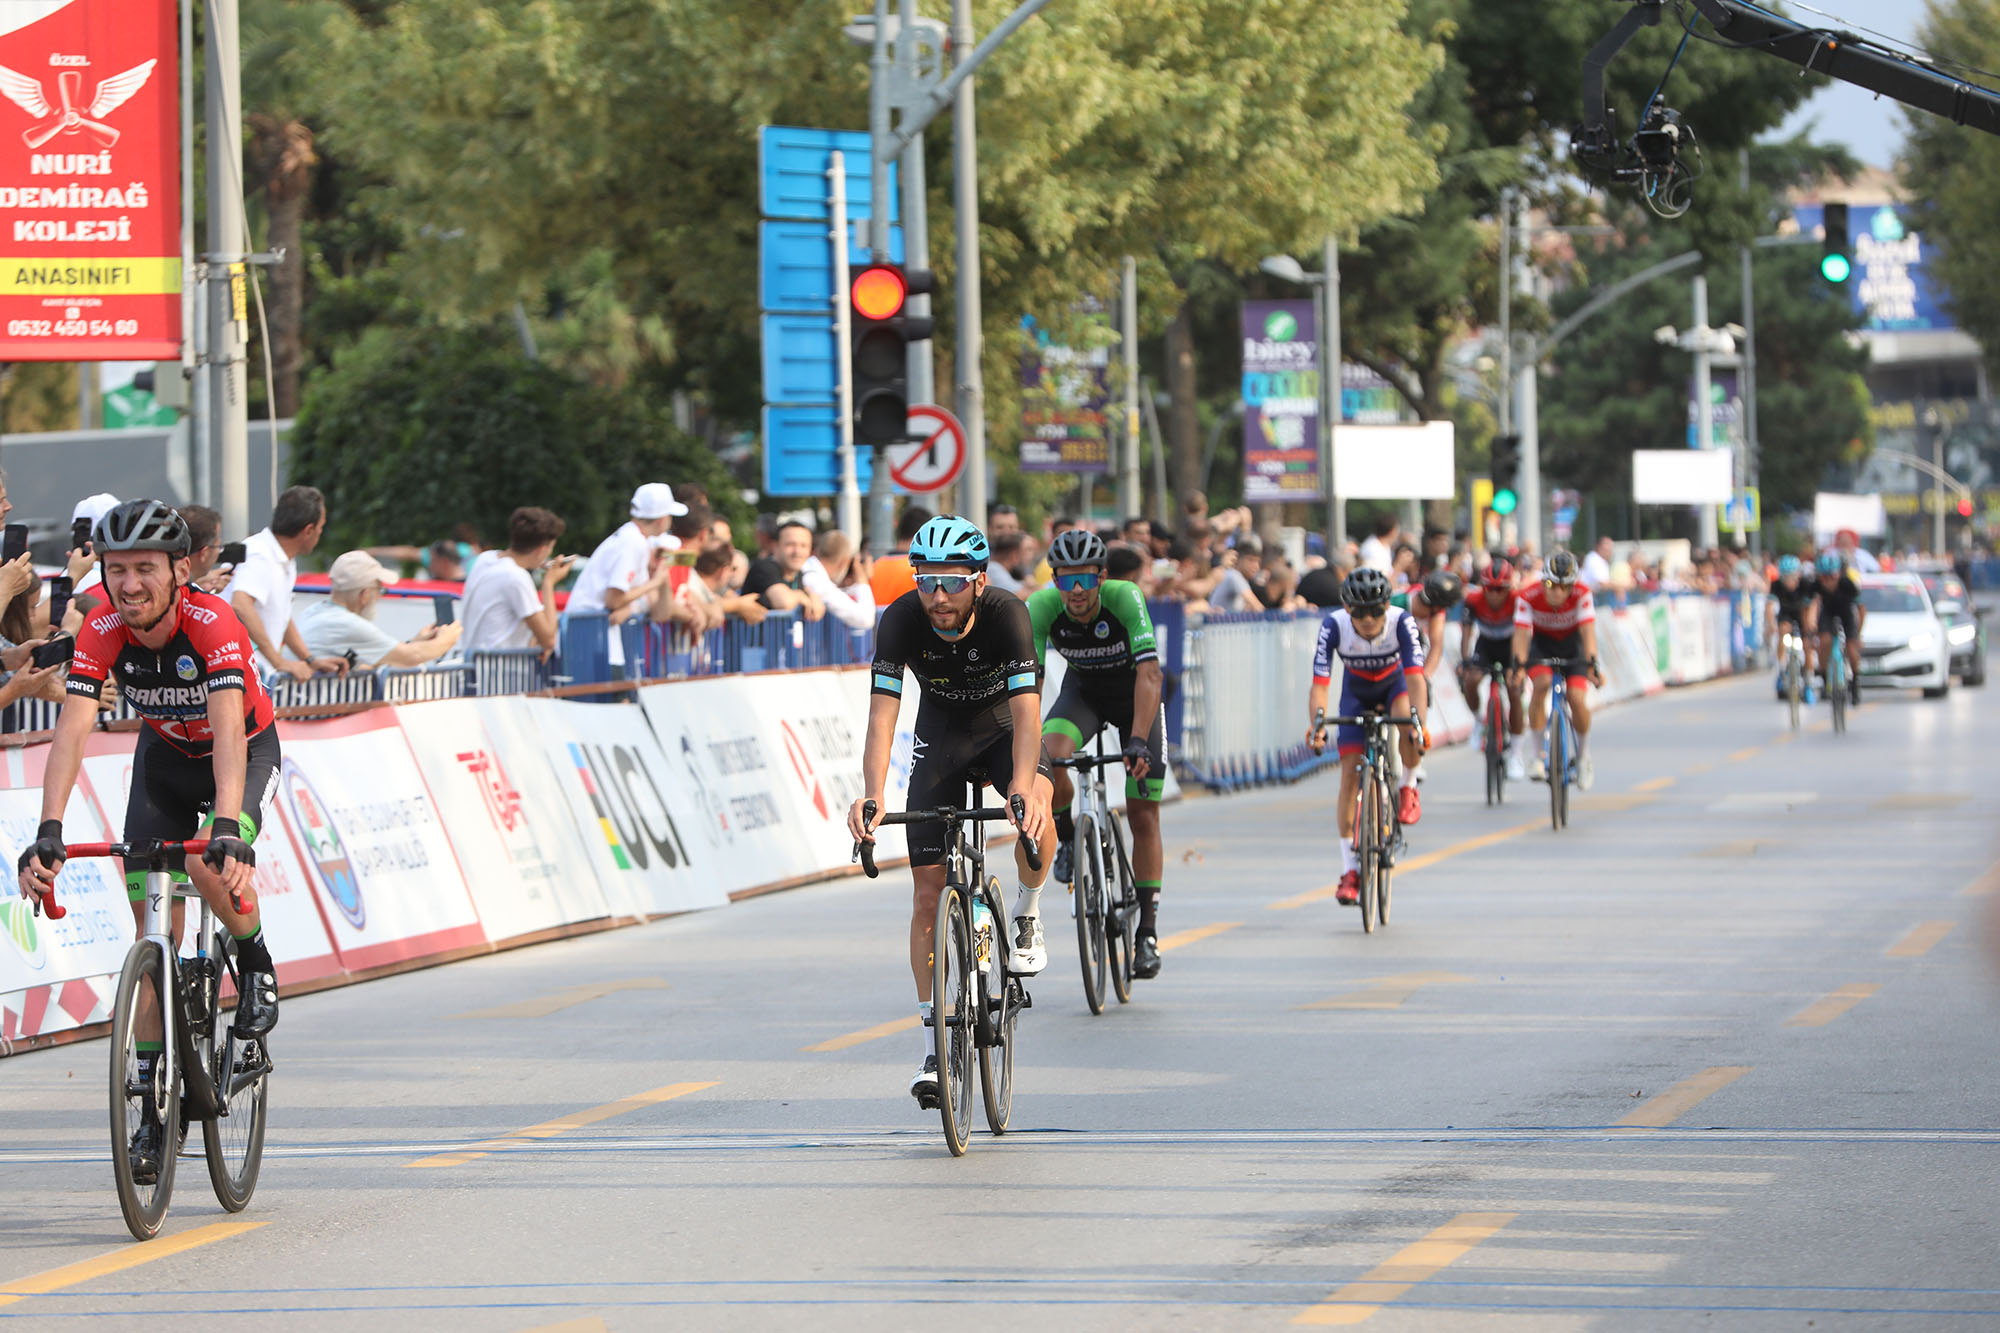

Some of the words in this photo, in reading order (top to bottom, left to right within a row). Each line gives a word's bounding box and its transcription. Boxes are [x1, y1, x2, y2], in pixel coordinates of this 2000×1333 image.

[49, 53, 91, 66] ÖZEL
[30, 150, 112, 175] NURİ
[0, 182, 149, 208] DEMİRAĞ
[13, 216, 131, 241] KOLEJİ
[15, 267, 130, 285] ANASINIFI
[8, 320, 51, 336] 0532
[53, 320, 88, 336] 450
[89, 320, 113, 336] 54
[90, 612, 123, 635] SHIM
[578, 744, 690, 870] UCI
